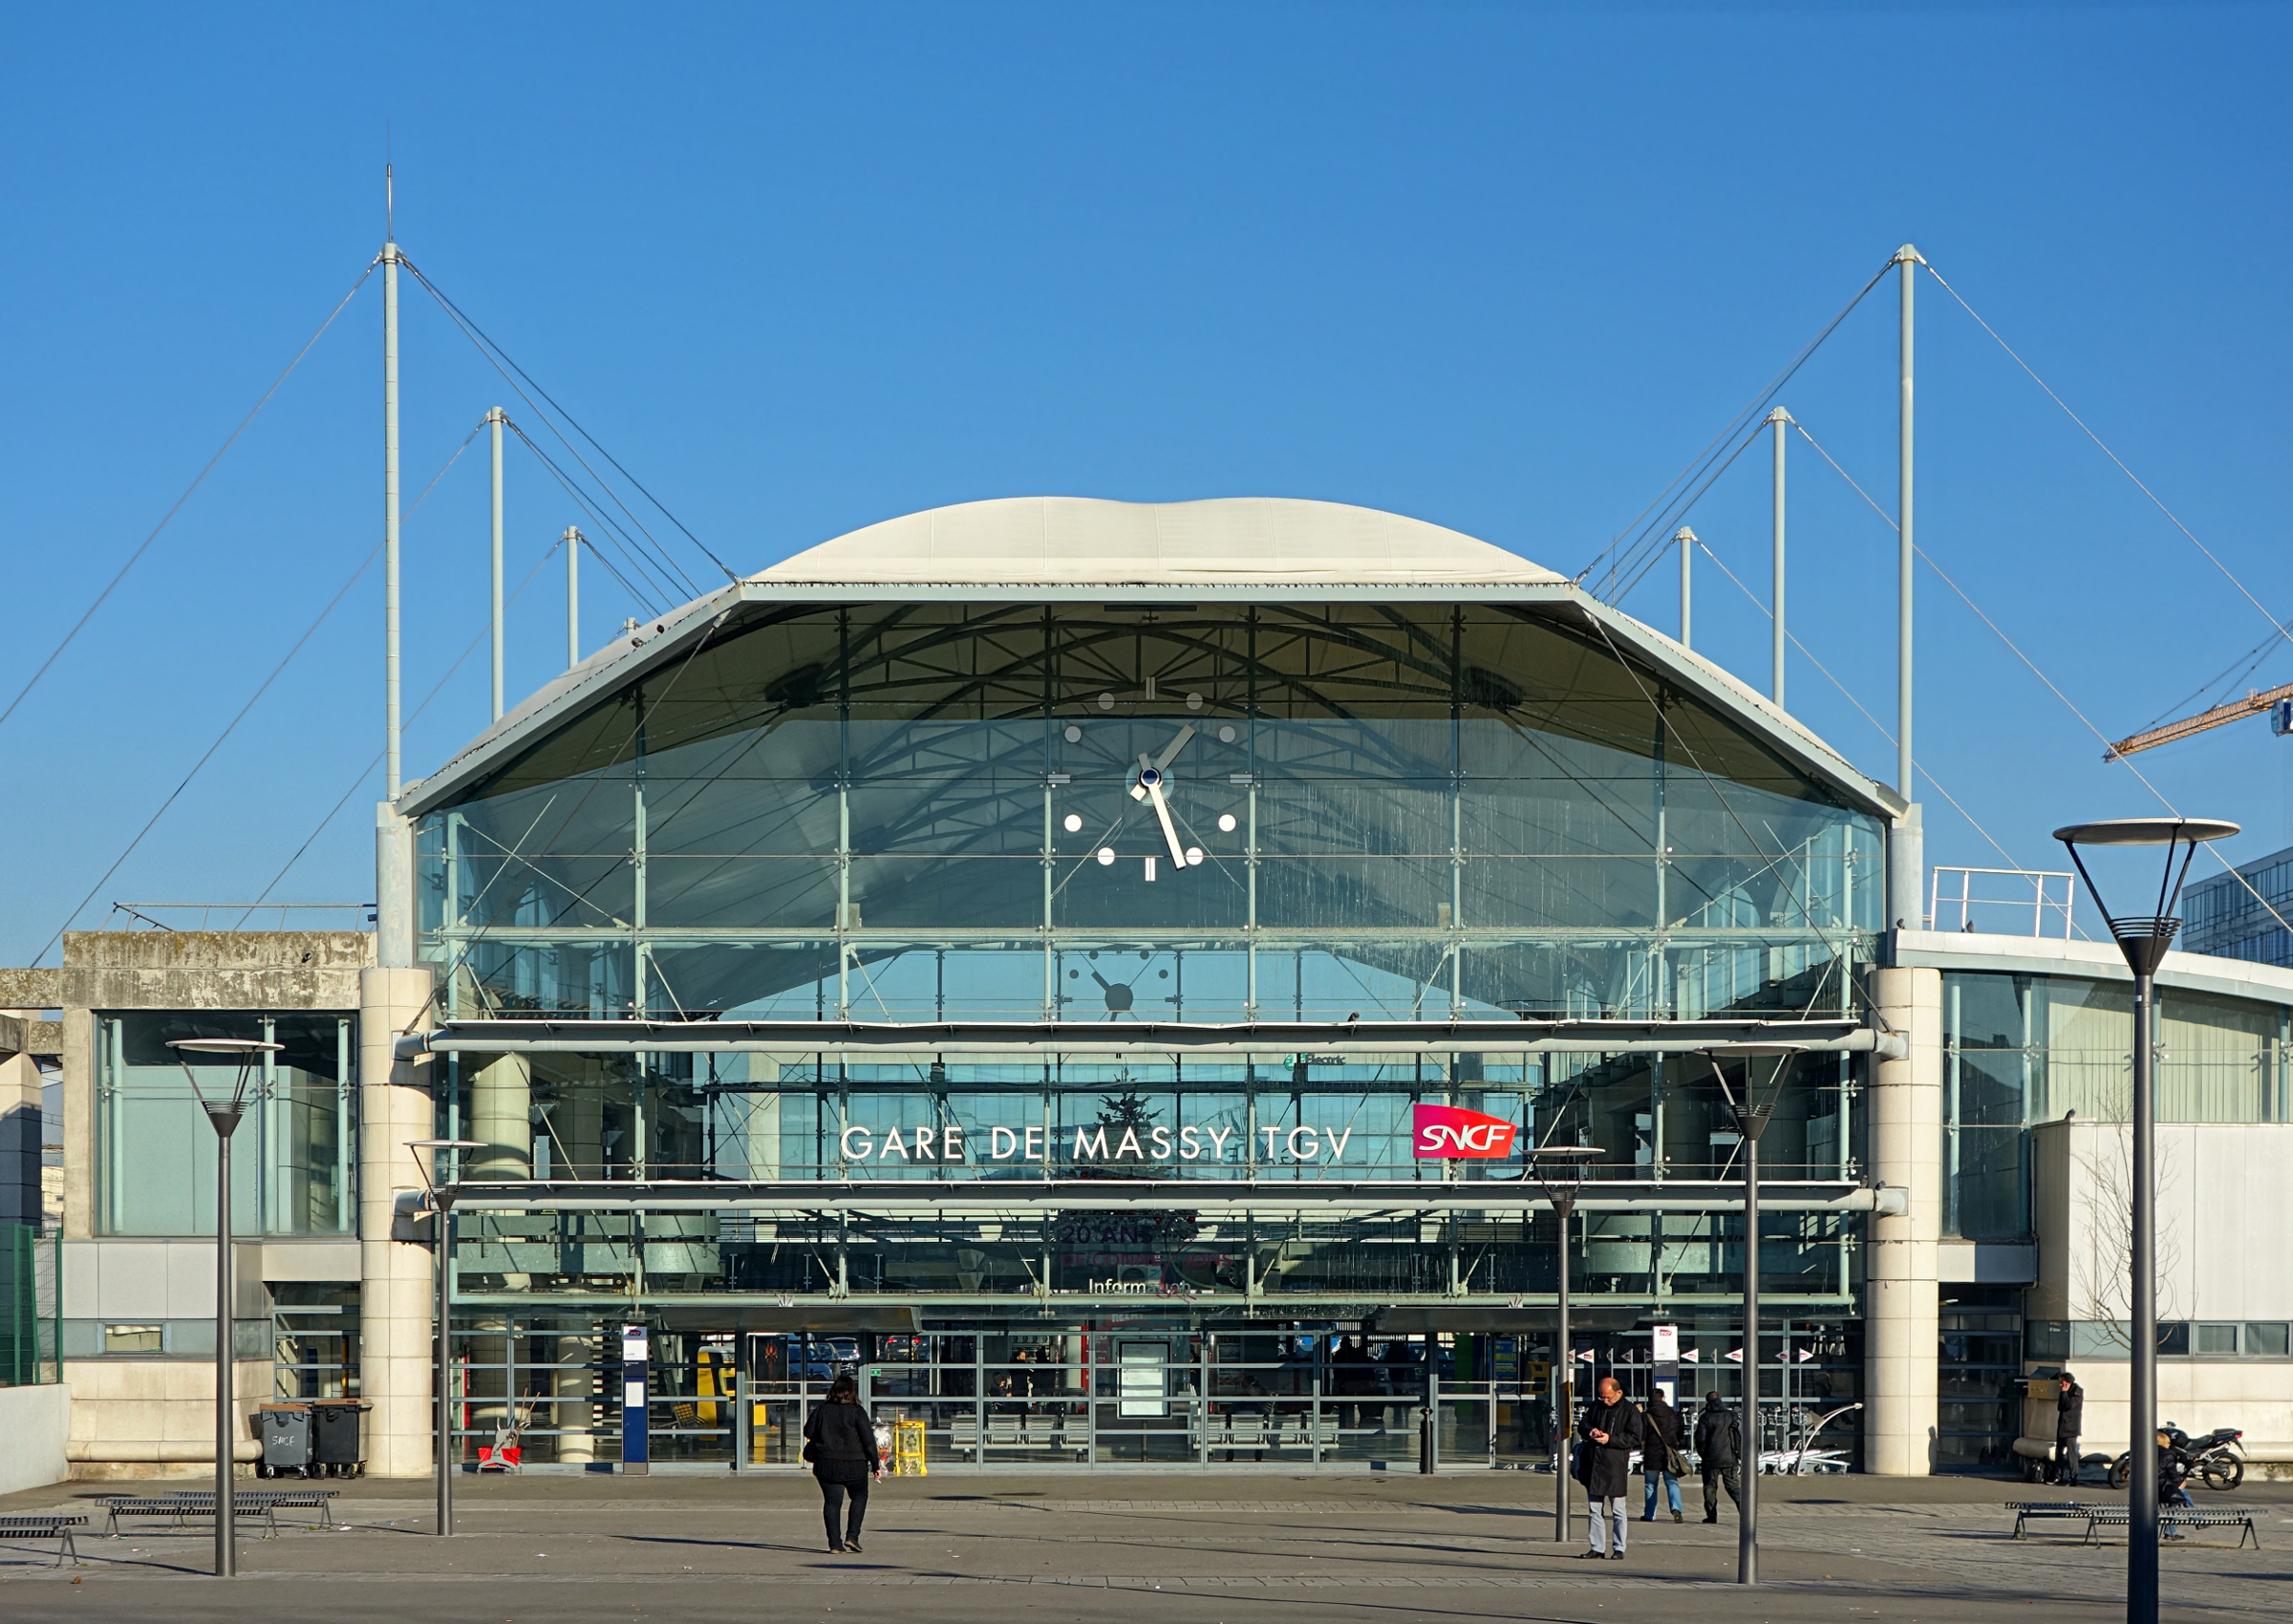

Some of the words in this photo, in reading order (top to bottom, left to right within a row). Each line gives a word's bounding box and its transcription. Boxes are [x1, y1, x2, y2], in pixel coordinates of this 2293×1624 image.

[841, 1125, 962, 1160] GARE
[992, 1126, 1043, 1159] DE
[1073, 1125, 1232, 1160] MASSY
[1261, 1125, 1352, 1160] TGV
[1418, 1124, 1511, 1151] SNCF
[1061, 1226, 1091, 1243] 20
[1101, 1226, 1154, 1244] ANS
[1061, 1252, 1086, 1267] DE
[1089, 1278, 1190, 1295] Informaion
